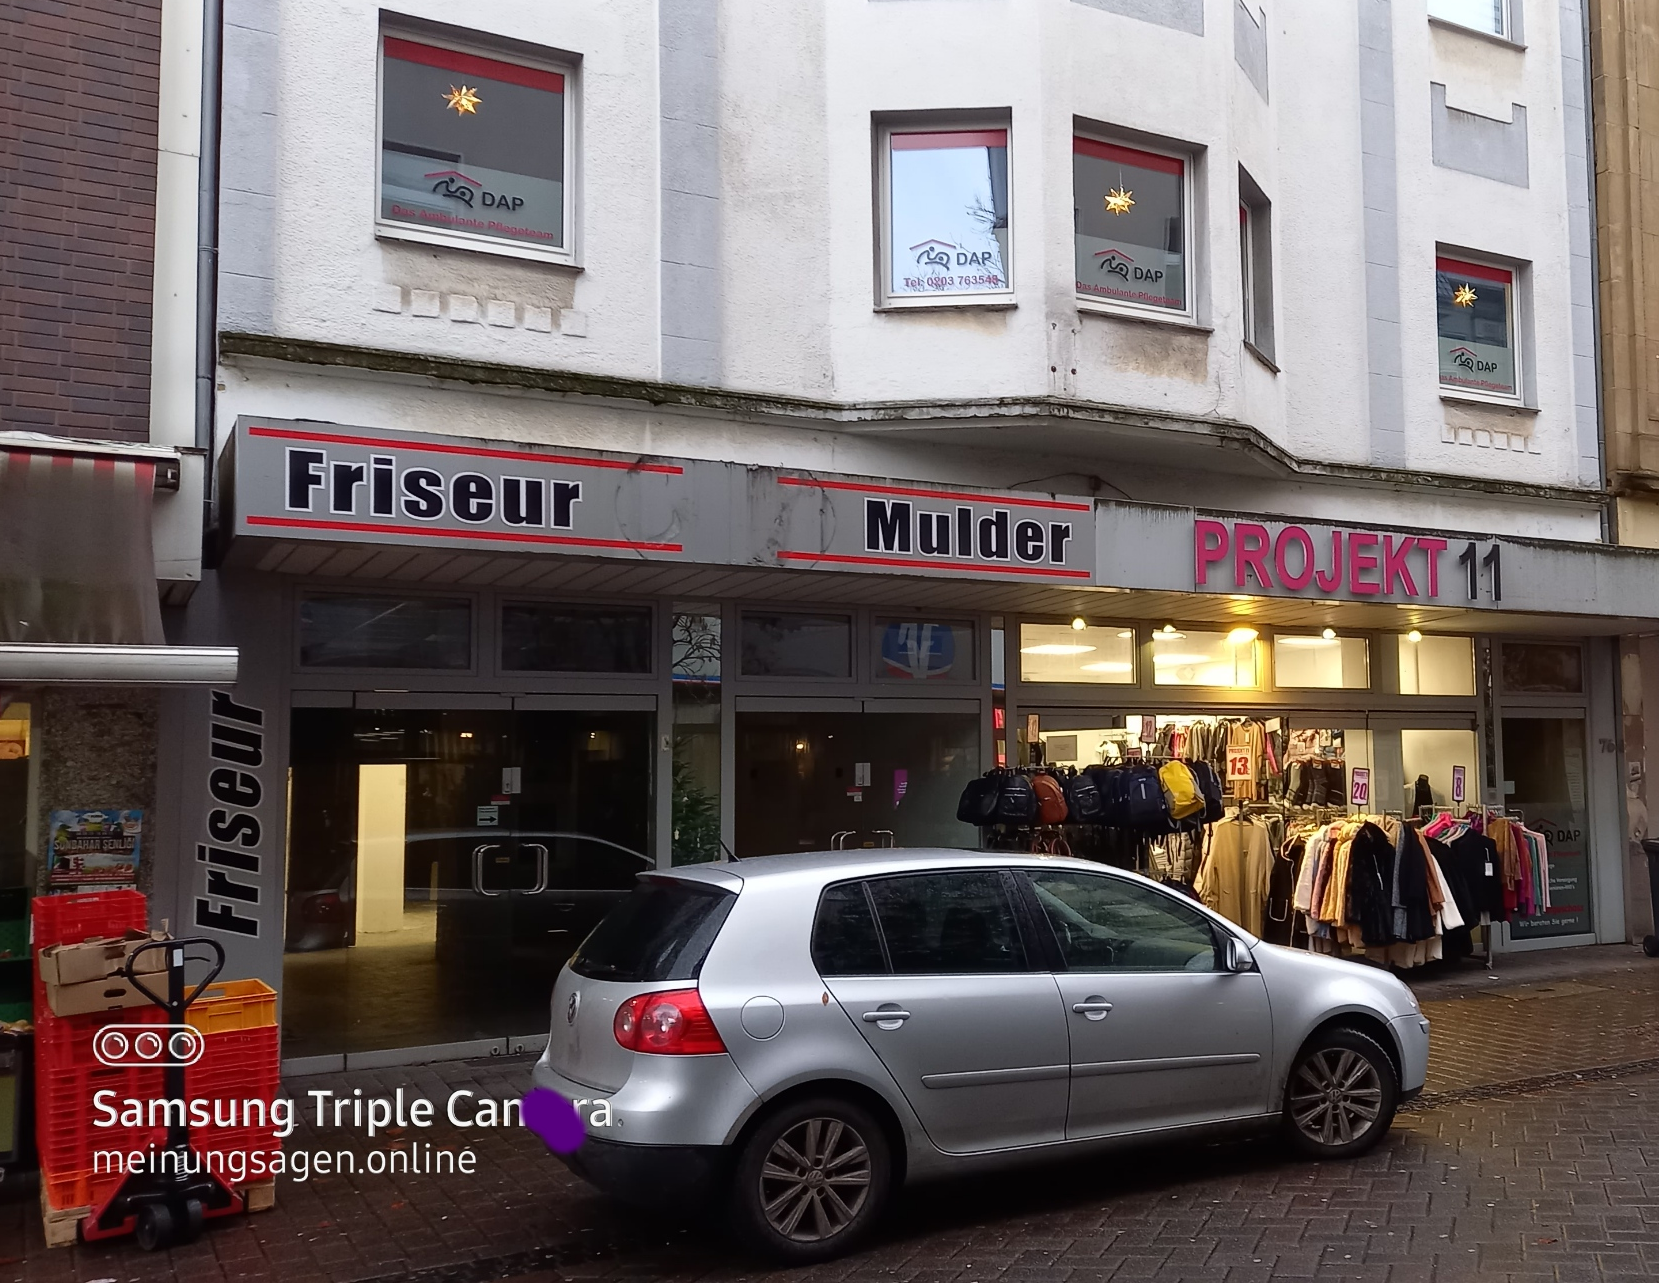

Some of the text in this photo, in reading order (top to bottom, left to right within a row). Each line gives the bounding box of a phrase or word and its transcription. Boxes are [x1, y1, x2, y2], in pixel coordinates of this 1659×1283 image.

[482, 191, 524, 211] DAP
[391, 204, 554, 240] Das Ambulante Pflegeteam
[956, 251, 992, 266] DAP
[1134, 267, 1163, 283] DAP
[1076, 281, 1182, 306] Das Ambulante Pflegeteam
[1477, 360, 1498, 373] DAP
[285, 446, 583, 530] Friseur
[864, 497, 1072, 565] Mulder
[1195, 519, 1501, 602] PROJEKT 11
[194, 689, 264, 939] Friseur
[1557, 830, 1581, 842] DAP
